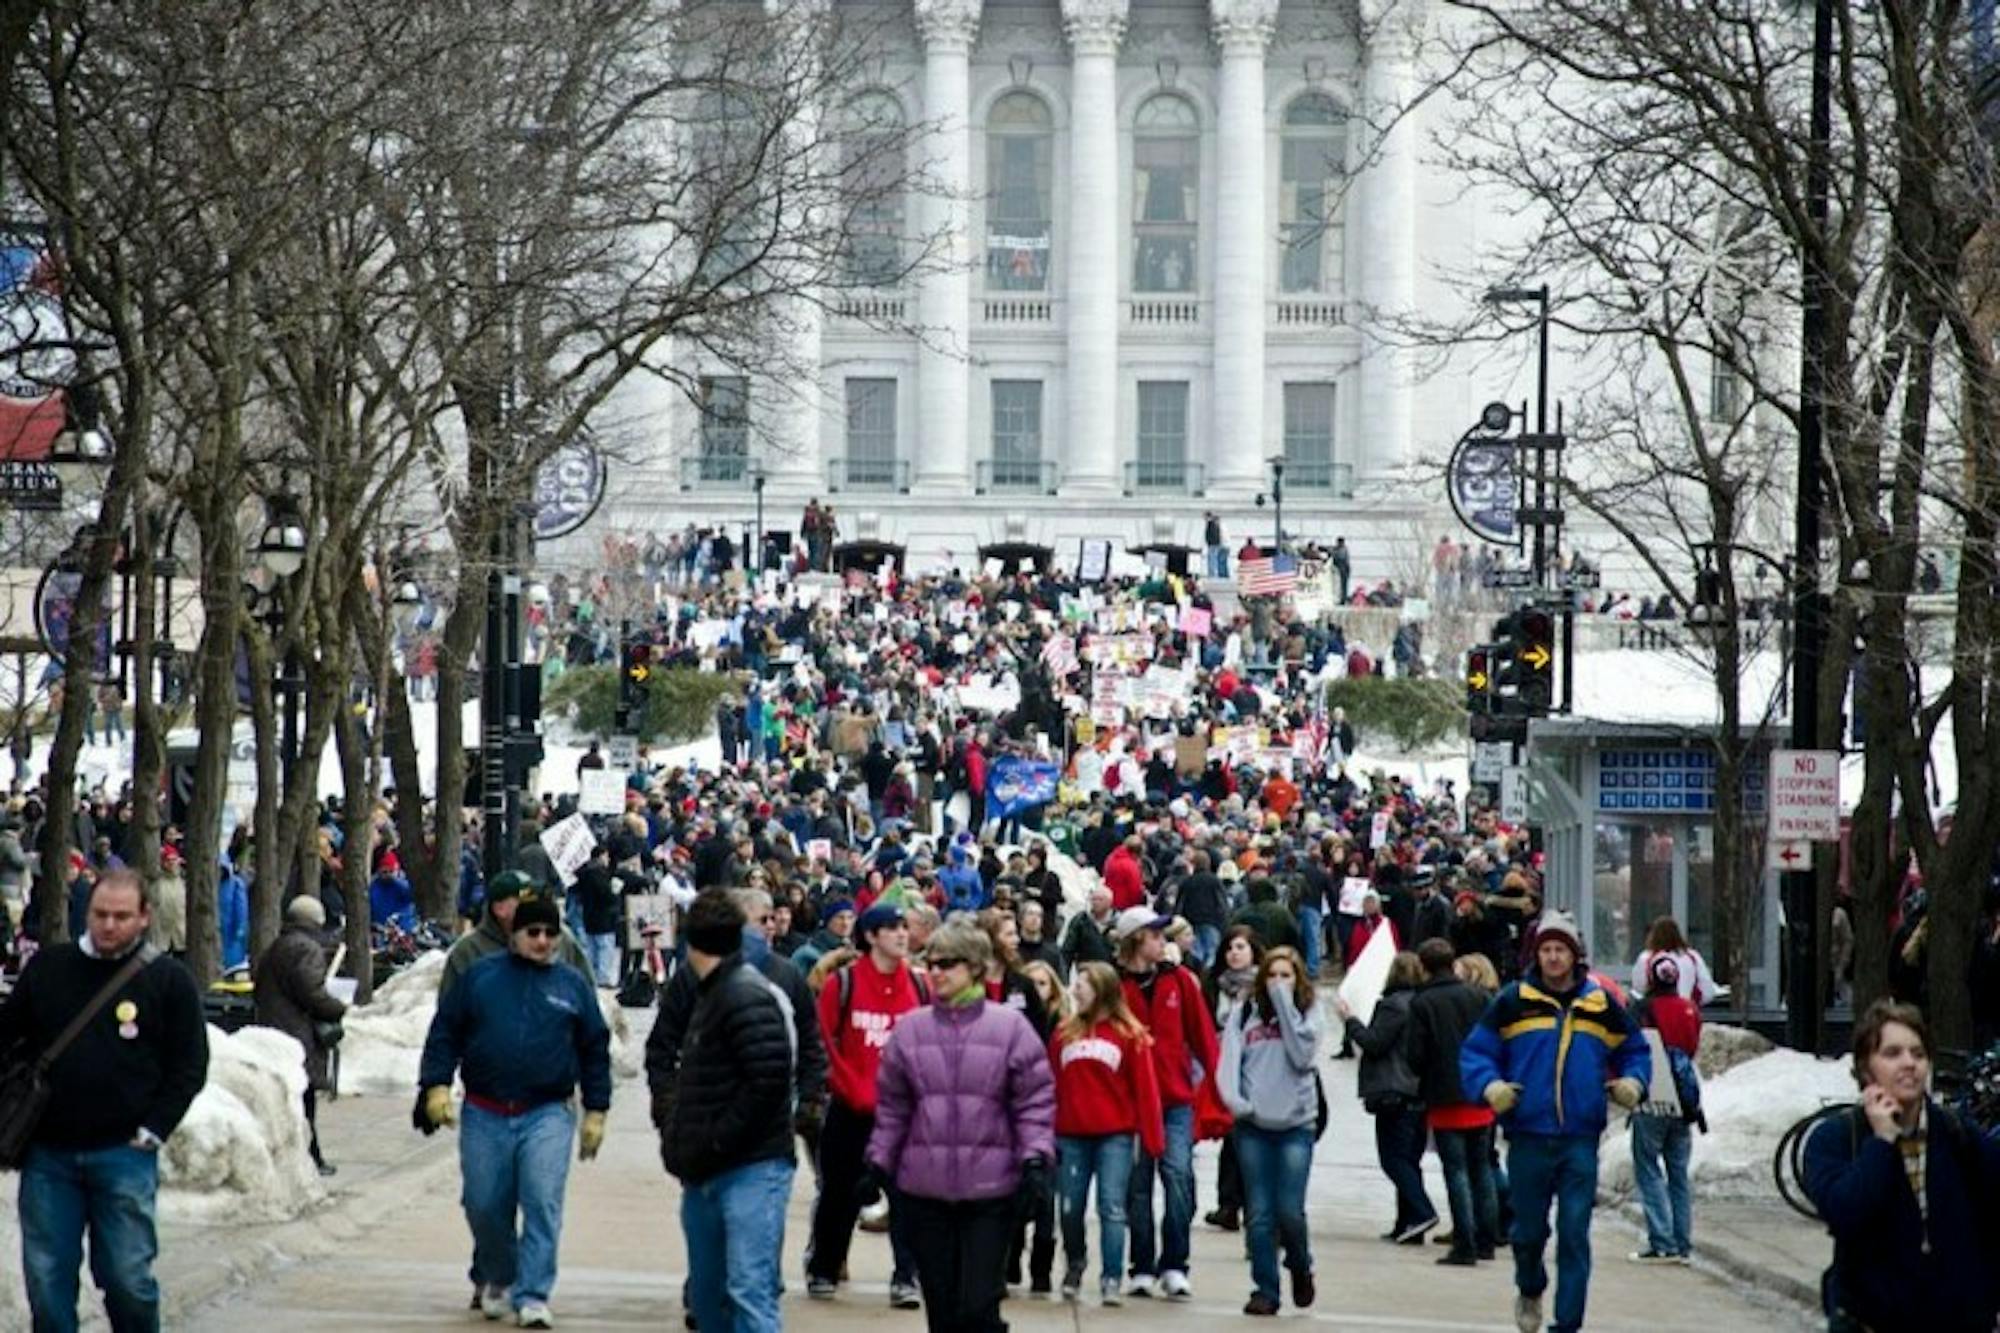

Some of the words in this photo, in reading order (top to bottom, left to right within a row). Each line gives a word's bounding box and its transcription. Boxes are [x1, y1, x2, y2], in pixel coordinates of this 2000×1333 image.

[1795, 758, 1816, 773] NO
[1777, 778, 1834, 790] STOPPING
[1777, 794, 1835, 807] STANDING
[1780, 817, 1831, 832] PARKING
